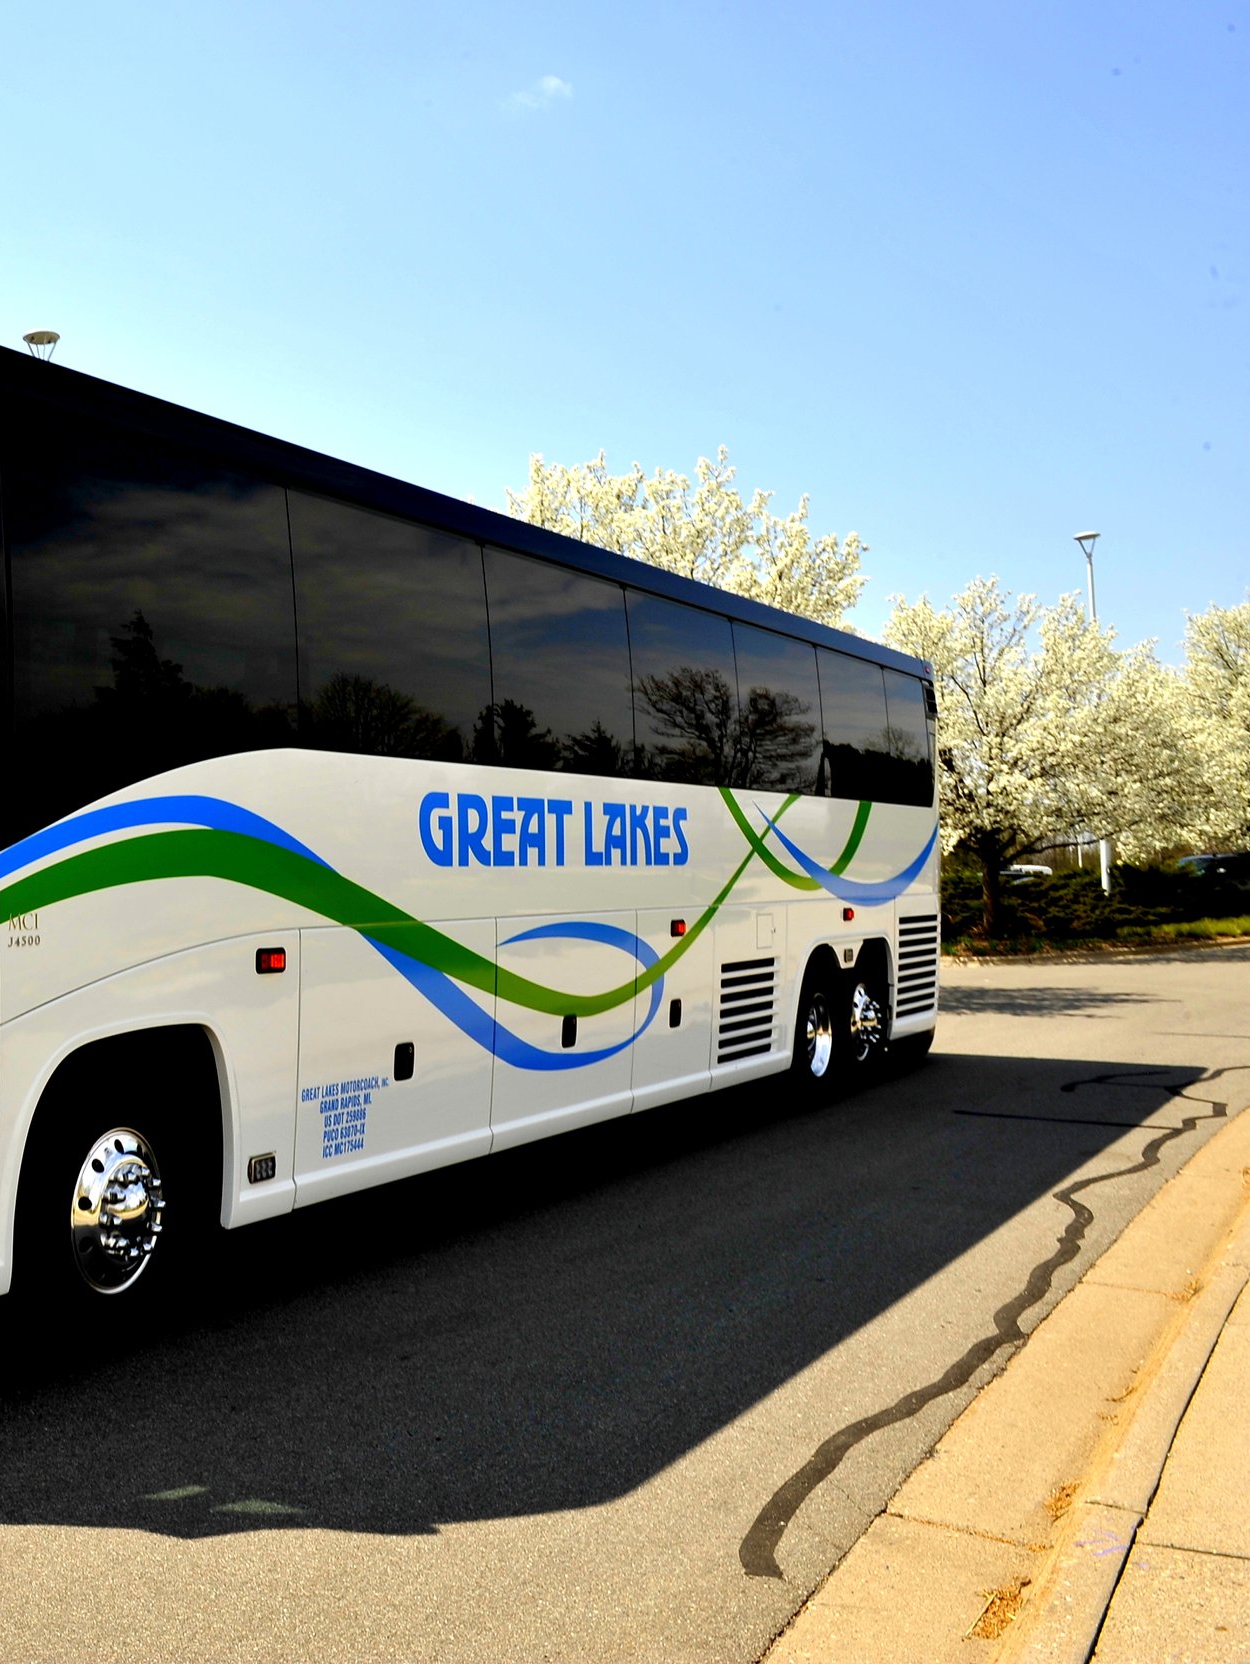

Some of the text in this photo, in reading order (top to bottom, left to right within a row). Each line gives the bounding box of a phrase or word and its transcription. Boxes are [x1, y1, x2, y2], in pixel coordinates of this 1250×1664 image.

[419, 791, 689, 867] GREAT LAKES
[8, 913, 38, 931] MCI
[7, 935, 41, 948] J4500
[301, 1086, 320, 1102] GREAT
[321, 1083, 339, 1098] LAKES
[319, 1099, 339, 1114] GRAND
[324, 1115, 332, 1129] US
[333, 1112, 345, 1126] DOT
[323, 1128, 339, 1143] PUCO
[322, 1137, 364, 1159] ICC MC175444
